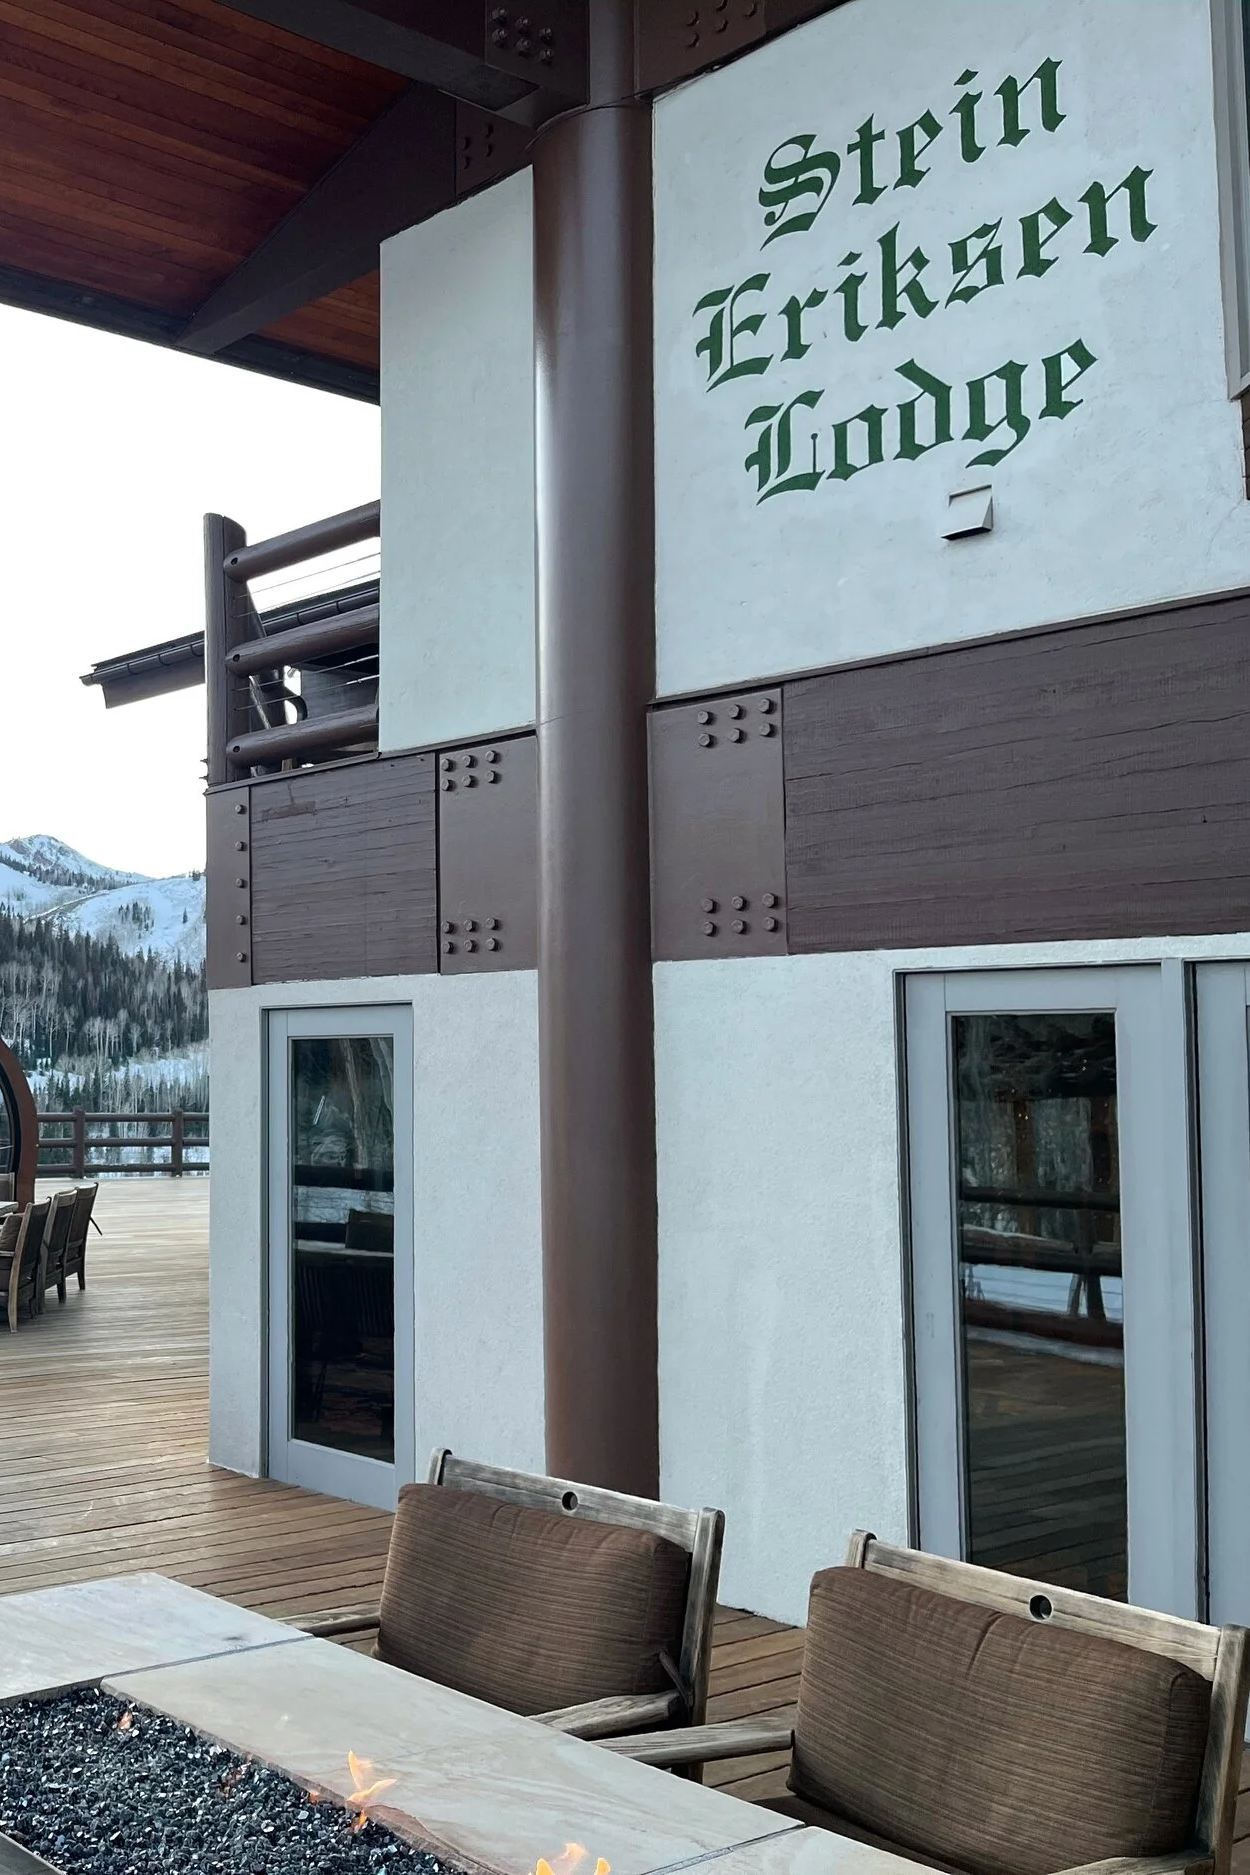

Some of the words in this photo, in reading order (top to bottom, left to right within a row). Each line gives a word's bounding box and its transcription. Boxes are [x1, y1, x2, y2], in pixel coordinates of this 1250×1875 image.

[759, 56, 1066, 250] Stein
[693, 165, 1158, 392] Eriksen
[744, 338, 1098, 506] Lodge
